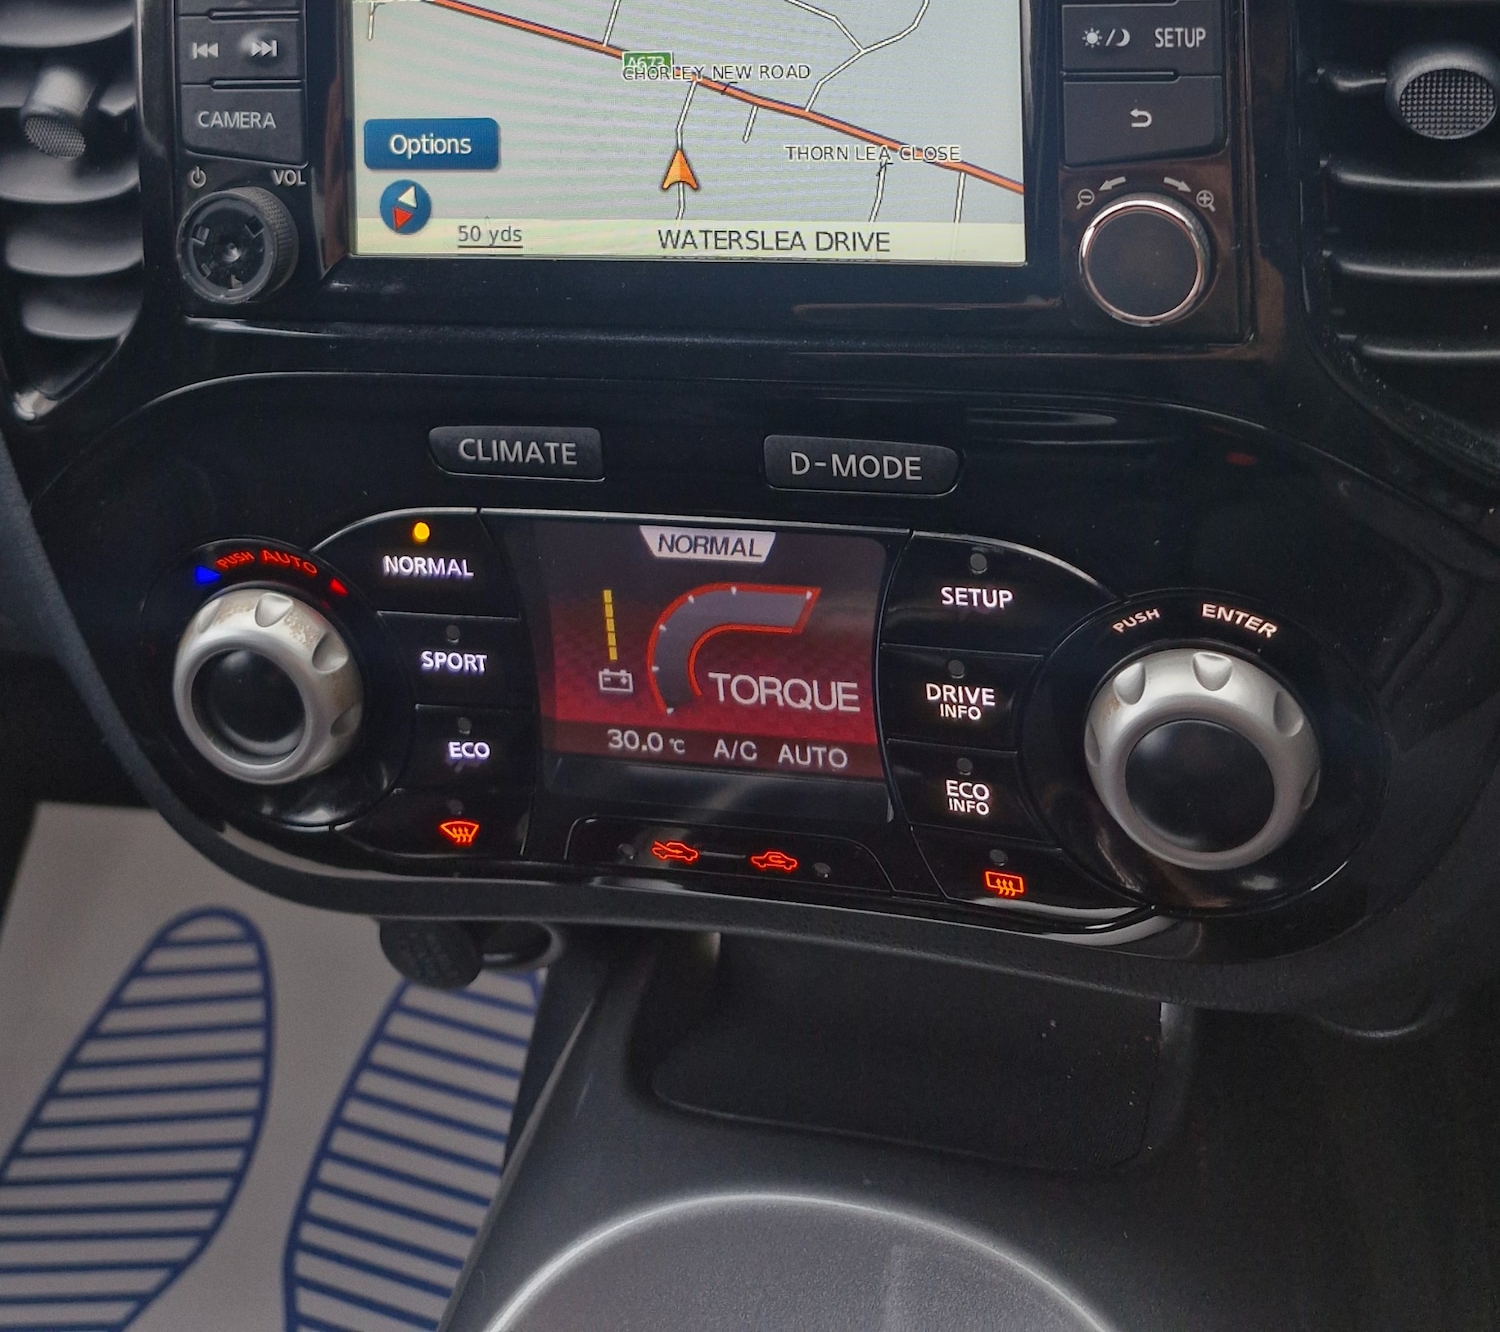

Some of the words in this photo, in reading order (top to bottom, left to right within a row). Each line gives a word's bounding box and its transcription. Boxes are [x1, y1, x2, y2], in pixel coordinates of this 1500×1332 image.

[1154, 27, 1206, 48] SETUP
[622, 66, 704, 80] CHORLEY
[712, 65, 752, 79] NEW
[759, 64, 811, 79] ROAD
[198, 111, 276, 129] CAMERA
[390, 133, 472, 160] Options
[785, 146, 848, 161] THORN
[856, 146, 891, 161] LEA
[899, 145, 960, 161] CLOSE
[271, 169, 306, 186] VOL
[458, 225, 481, 242] 50
[488, 225, 523, 247] yds
[658, 229, 806, 251] WATERSLEA
[816, 231, 890, 252] DRIVE
[458, 438, 578, 466] CLIMATE
[790, 451, 923, 481] D-MODE
[657, 533, 763, 558] NORMAL
[216, 551, 255, 570] PUSH
[261, 549, 318, 576] AUTO
[383, 555, 474, 578] NORMAL
[941, 587, 1013, 609] SETUP
[1112, 608, 1161, 634] PUSH
[1202, 603, 1278, 639] ENTER
[421, 650, 488, 673] SPORT
[708, 671, 861, 713] TORQUE
[925, 683, 996, 706] DRIVE
[939, 703, 982, 720] INFO
[448, 741, 490, 761] ECO
[607, 728, 664, 752] 30.0
[713, 739, 758, 761] A/C
[778, 744, 848, 768] AUTO
[945, 779, 990, 801] ECO
[949, 798, 990, 816] INFO
